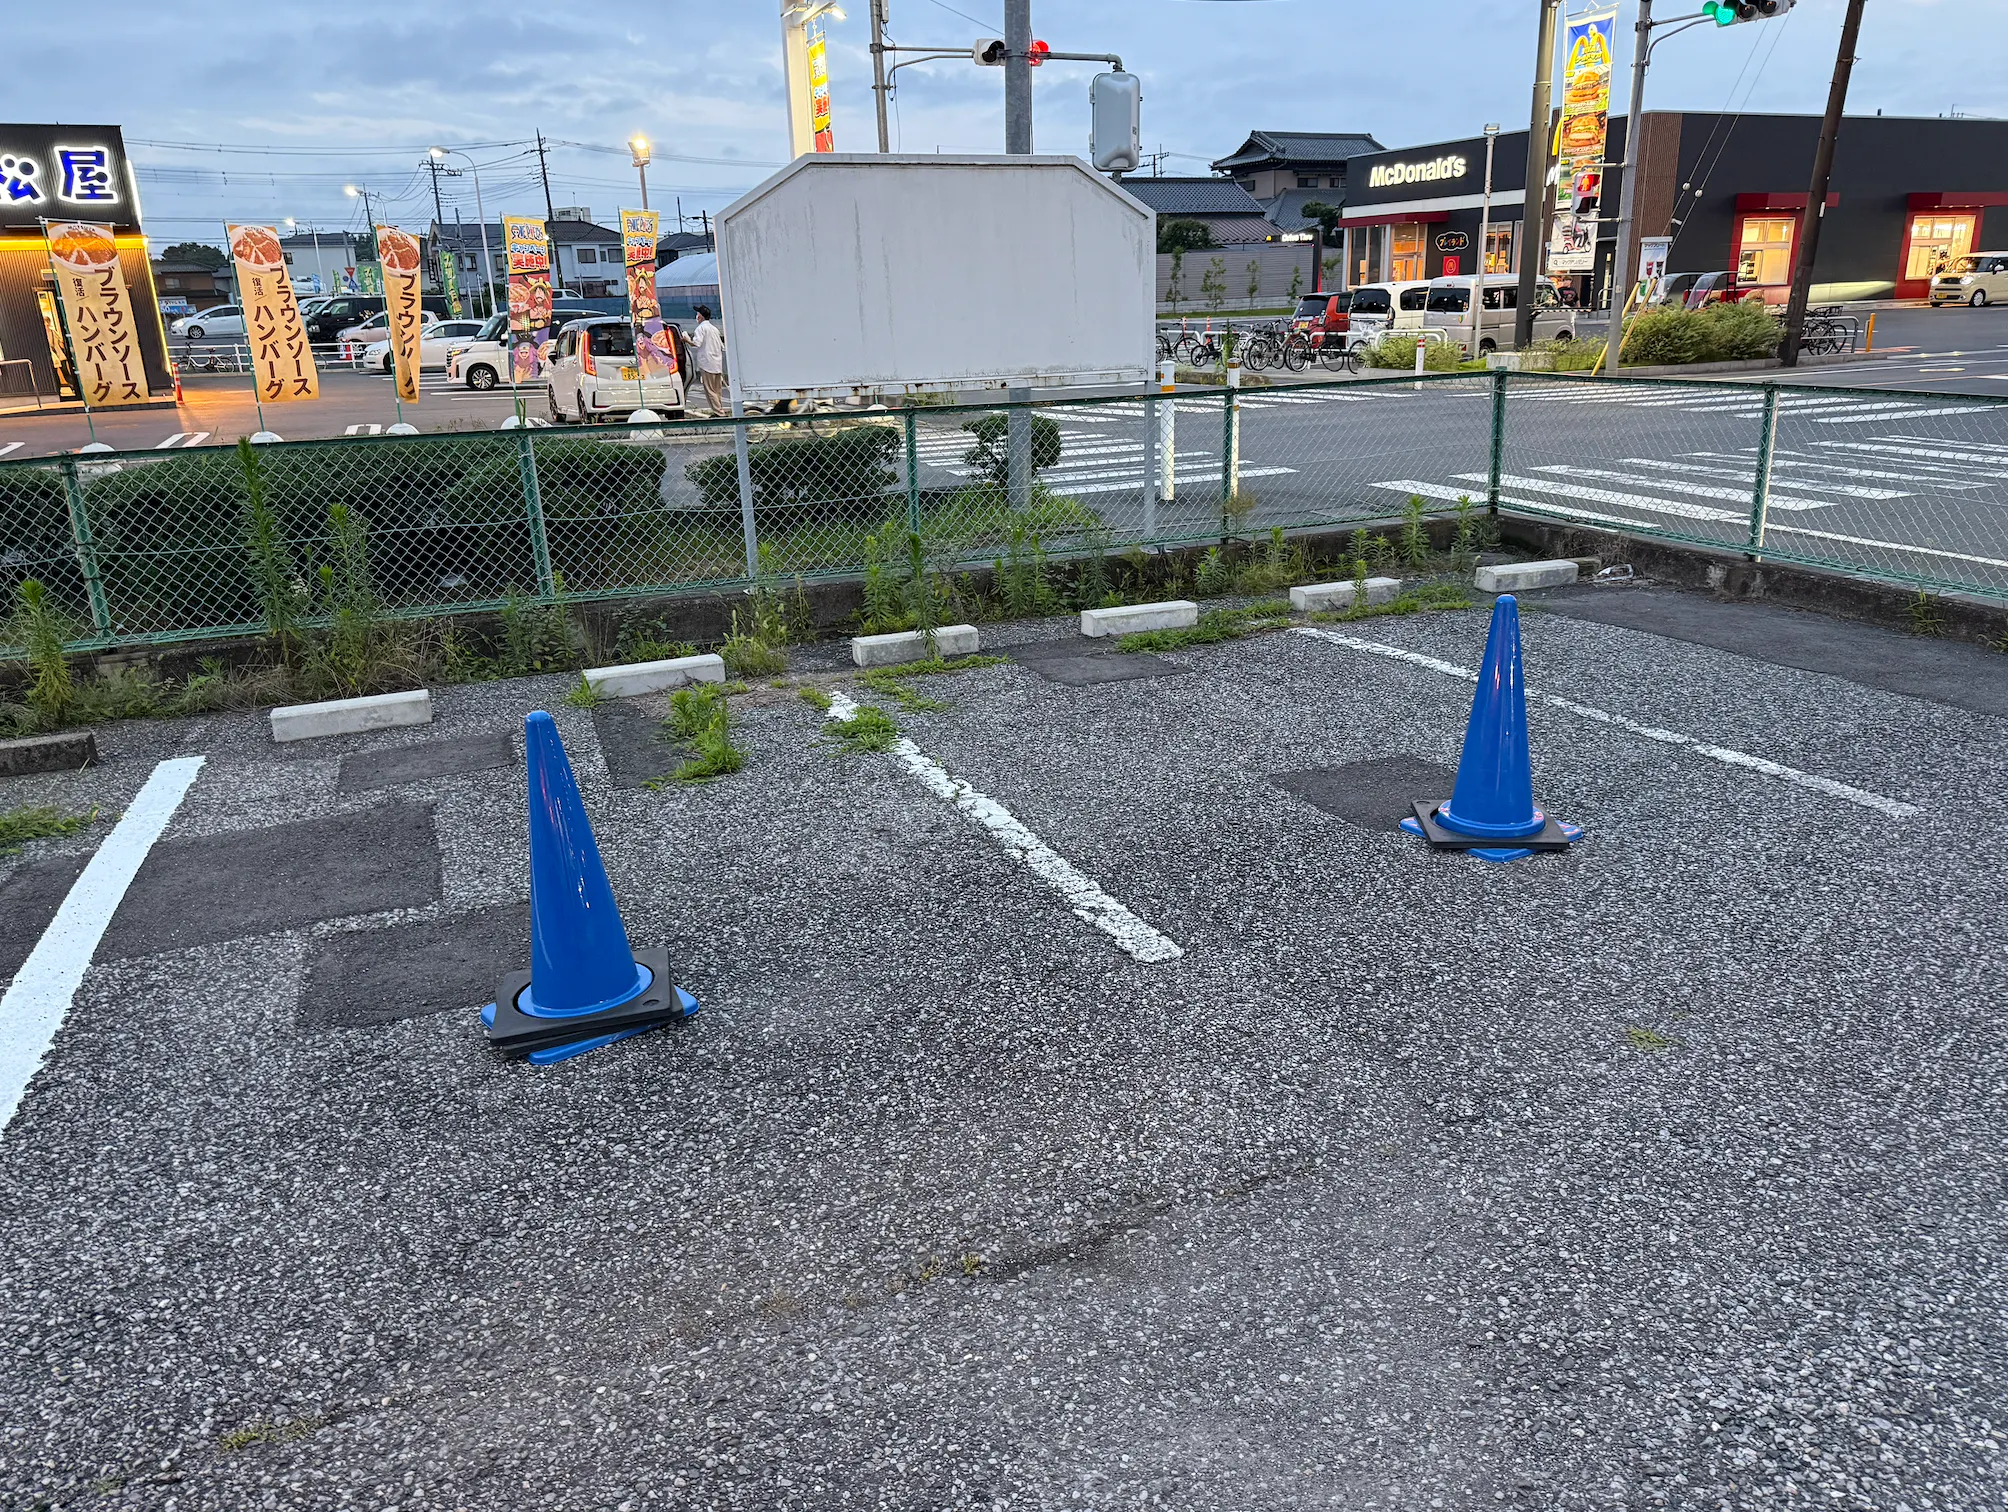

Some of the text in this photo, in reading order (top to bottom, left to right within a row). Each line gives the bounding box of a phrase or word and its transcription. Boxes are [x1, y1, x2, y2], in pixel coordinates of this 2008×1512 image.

[1369, 156, 1467, 188] McDonald's
[72, 277, 86, 297] 復活
[94, 266, 141, 400] ブラウンソース
[252, 277, 264, 296] 復活
[270, 265, 312, 396] ブラウンソース
[77, 306, 113, 402] ハンバーグ
[254, 305, 285, 400] ハンバーグ
